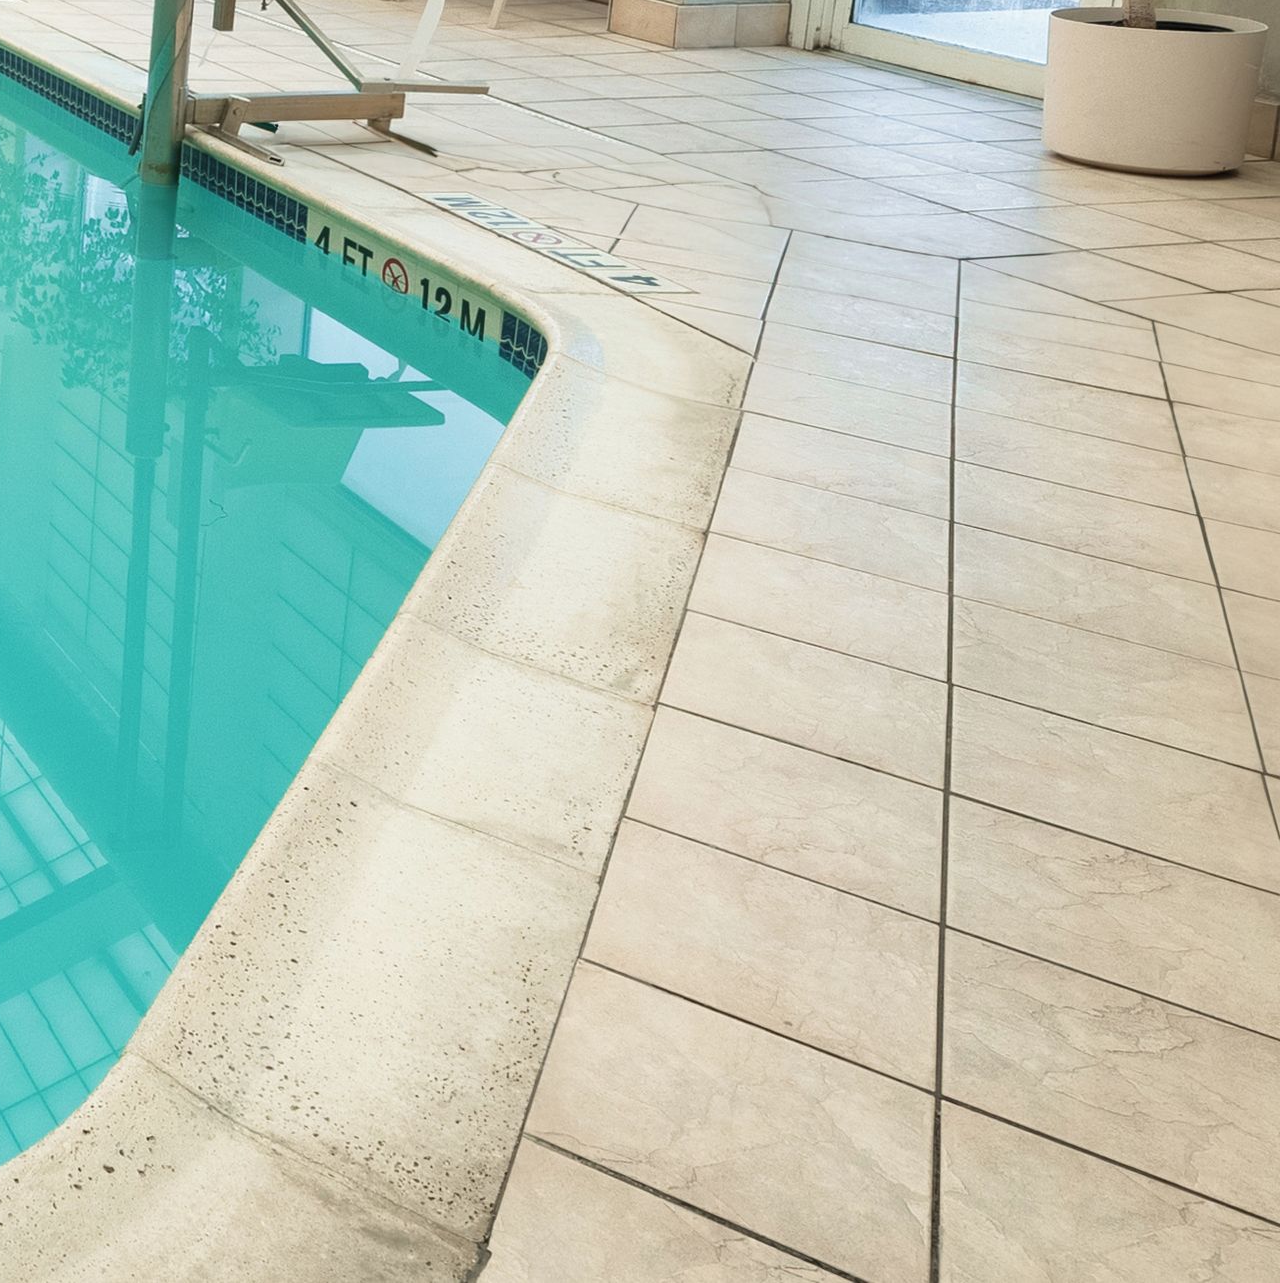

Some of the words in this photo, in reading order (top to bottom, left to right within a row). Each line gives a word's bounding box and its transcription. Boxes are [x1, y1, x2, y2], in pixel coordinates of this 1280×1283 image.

[314, 225, 330, 255] 4
[343, 236, 374, 277] FT
[549, 250, 627, 269] FT
[609, 274, 661, 287] 4
